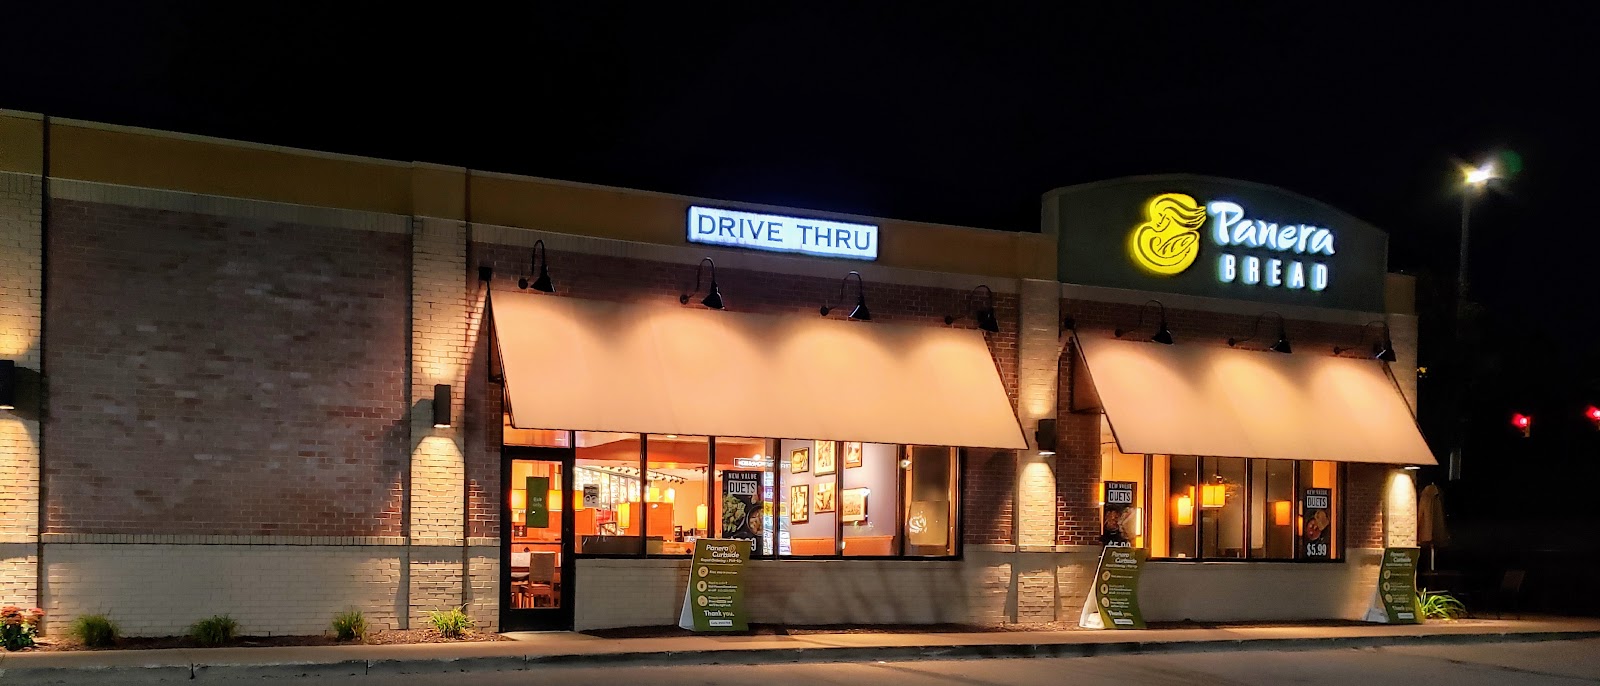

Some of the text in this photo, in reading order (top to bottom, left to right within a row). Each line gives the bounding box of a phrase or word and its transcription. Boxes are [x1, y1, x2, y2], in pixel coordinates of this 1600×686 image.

[698, 213, 871, 251] DRIVE THRU
[1208, 201, 1335, 255] Panera
[1220, 254, 1329, 291] BREAD
[728, 472, 740, 480] NEW
[729, 481, 757, 494] DUETS
[1109, 491, 1131, 502] DUETS
[1307, 497, 1327, 507] DUETS
[705, 544, 729, 552] Panera
[1306, 542, 1327, 557] $5.99
